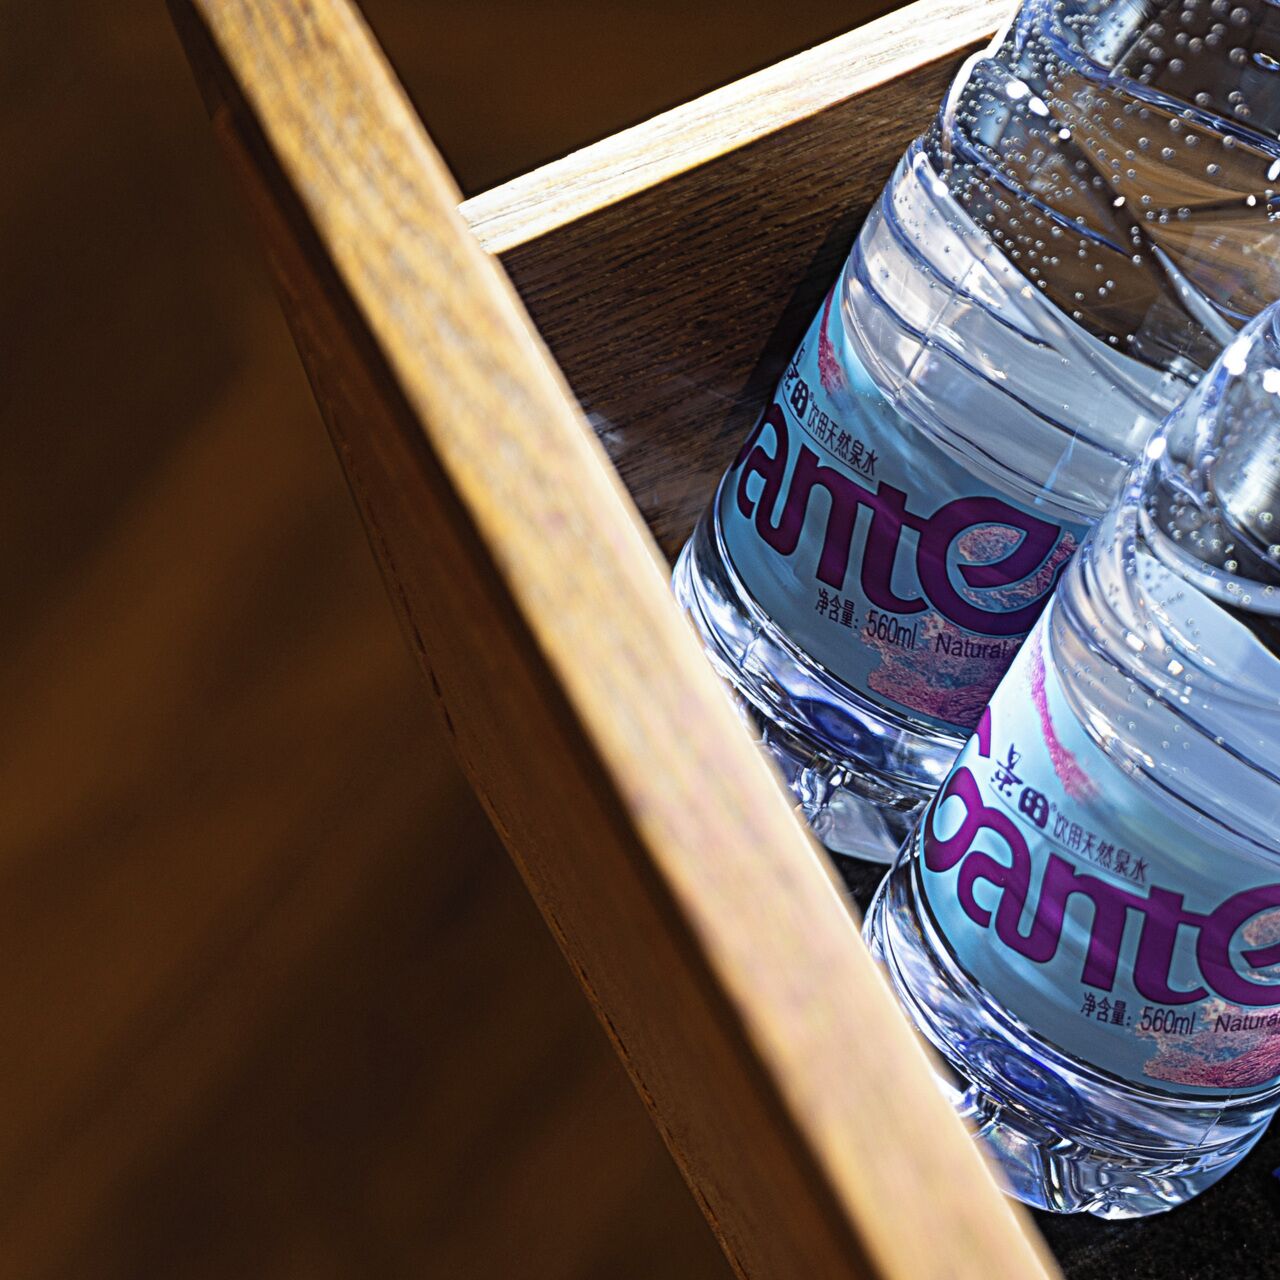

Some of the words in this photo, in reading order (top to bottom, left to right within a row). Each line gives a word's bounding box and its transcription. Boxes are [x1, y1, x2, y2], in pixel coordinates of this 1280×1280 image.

[935, 632, 1008, 660] Natural
[1053, 814, 1151, 882] 饮用天然泉水
